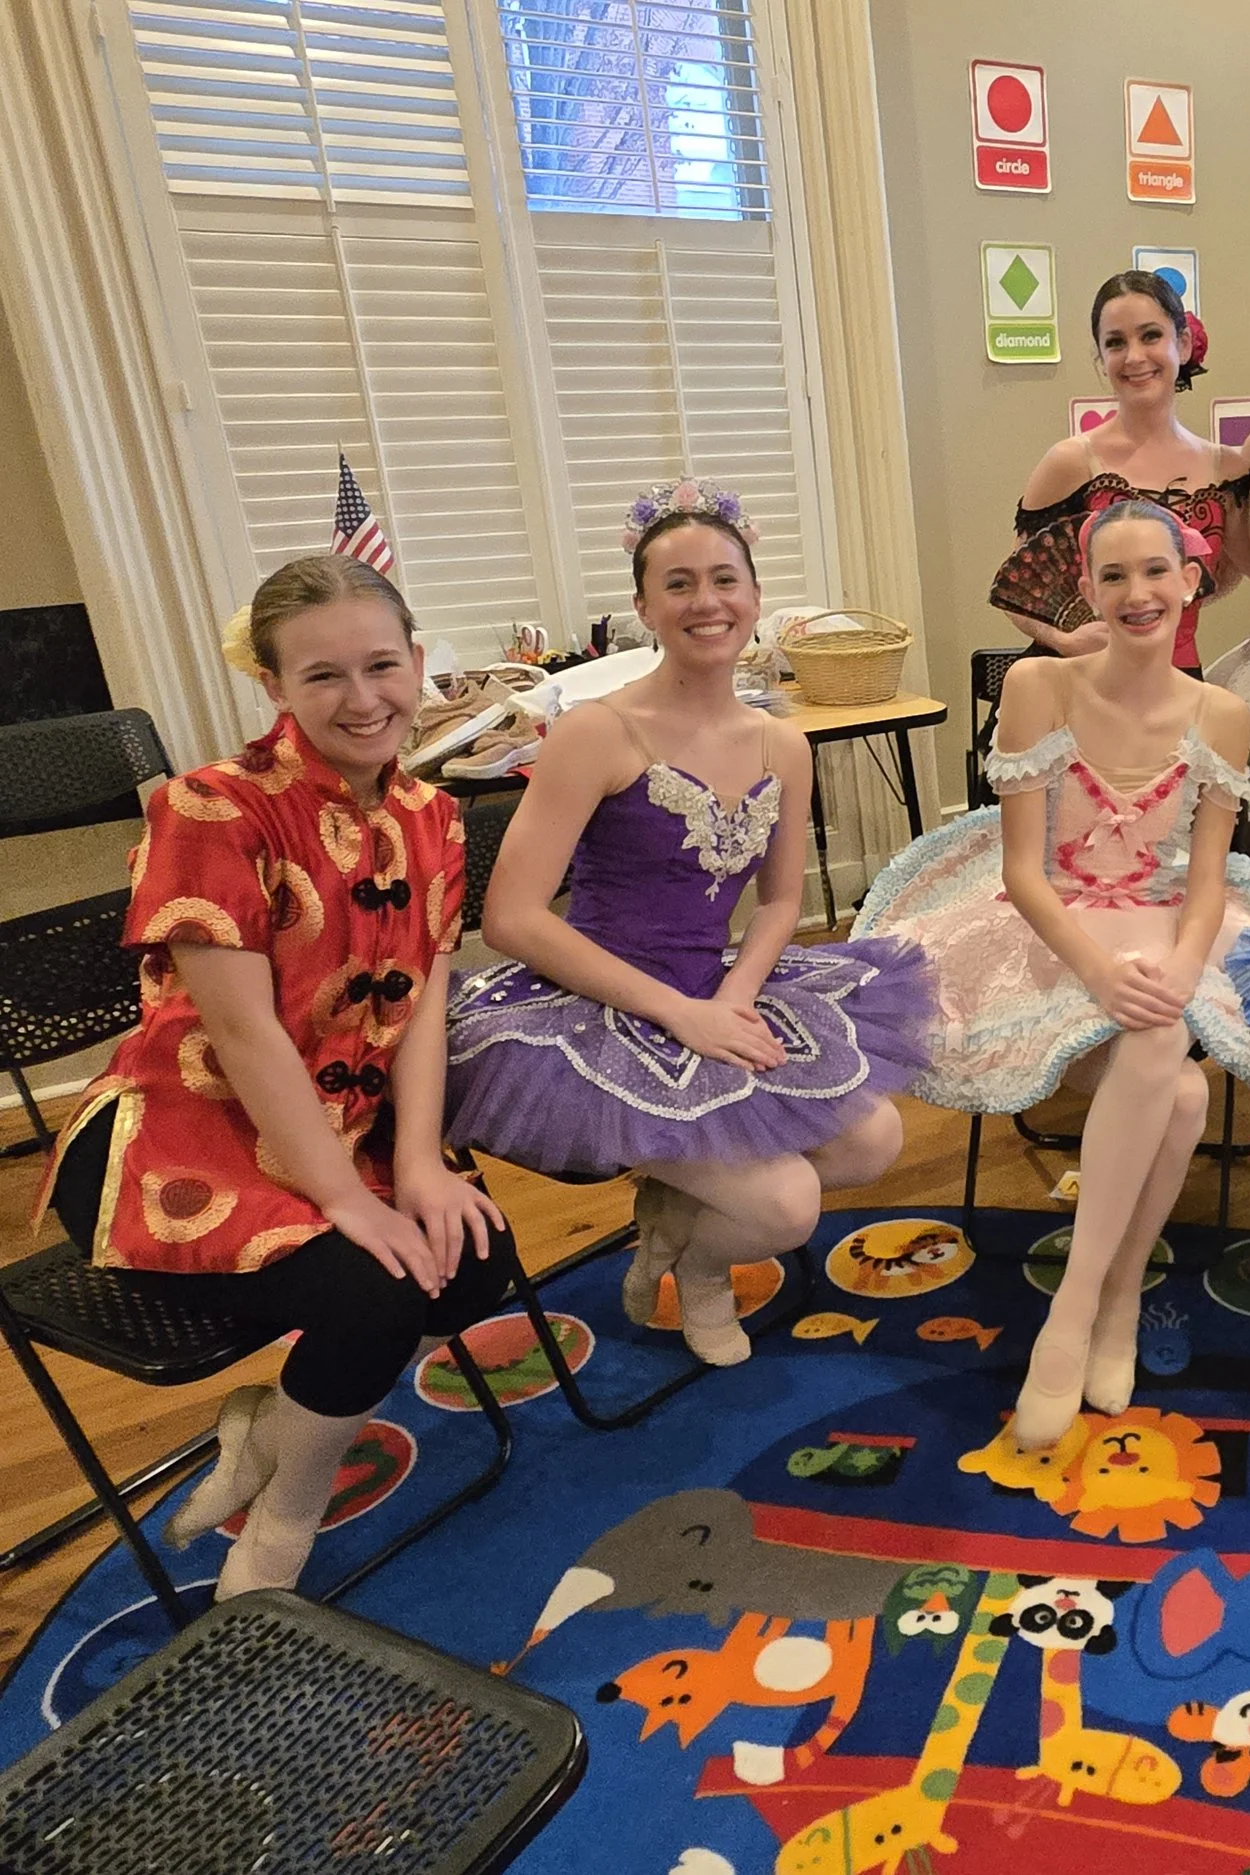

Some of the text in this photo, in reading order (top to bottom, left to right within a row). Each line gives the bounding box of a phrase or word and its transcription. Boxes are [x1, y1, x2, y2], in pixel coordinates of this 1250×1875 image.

[995, 158, 1030, 175] circle
[1138, 171, 1184, 191] triangle
[995, 332, 1051, 348] diamond
